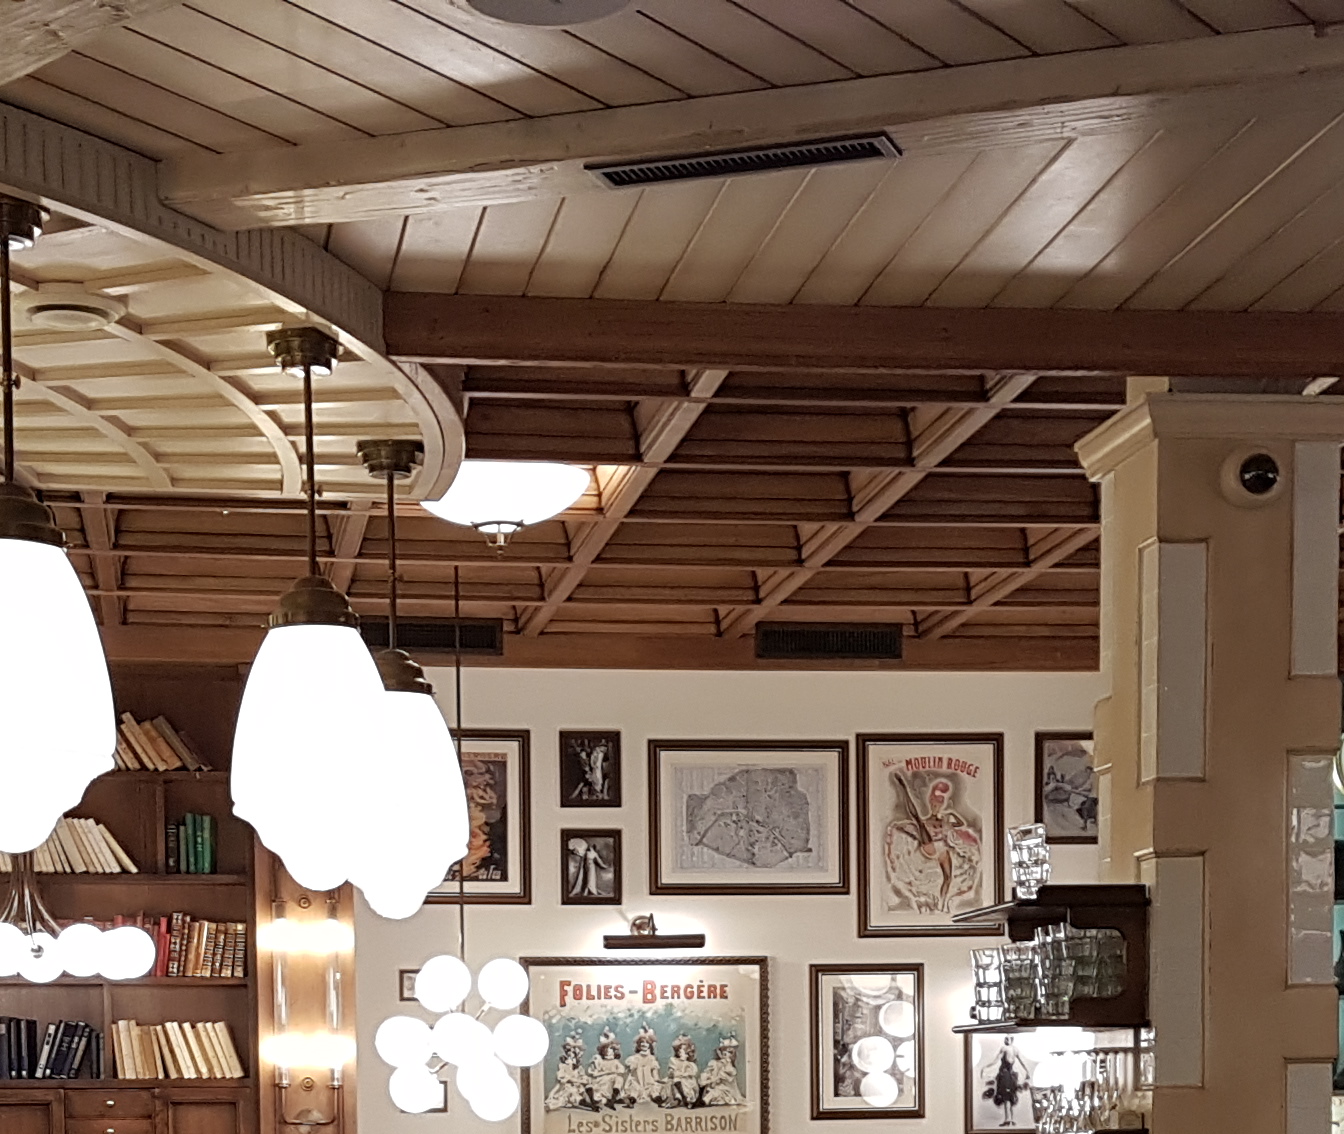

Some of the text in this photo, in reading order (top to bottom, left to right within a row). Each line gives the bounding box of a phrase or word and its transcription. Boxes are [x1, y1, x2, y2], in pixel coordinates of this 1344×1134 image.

[905, 756, 944, 771] MOULIN
[946, 757, 980, 778] ROUGE
[567, 1113, 738, 1133] Les Sisters BARRISON
